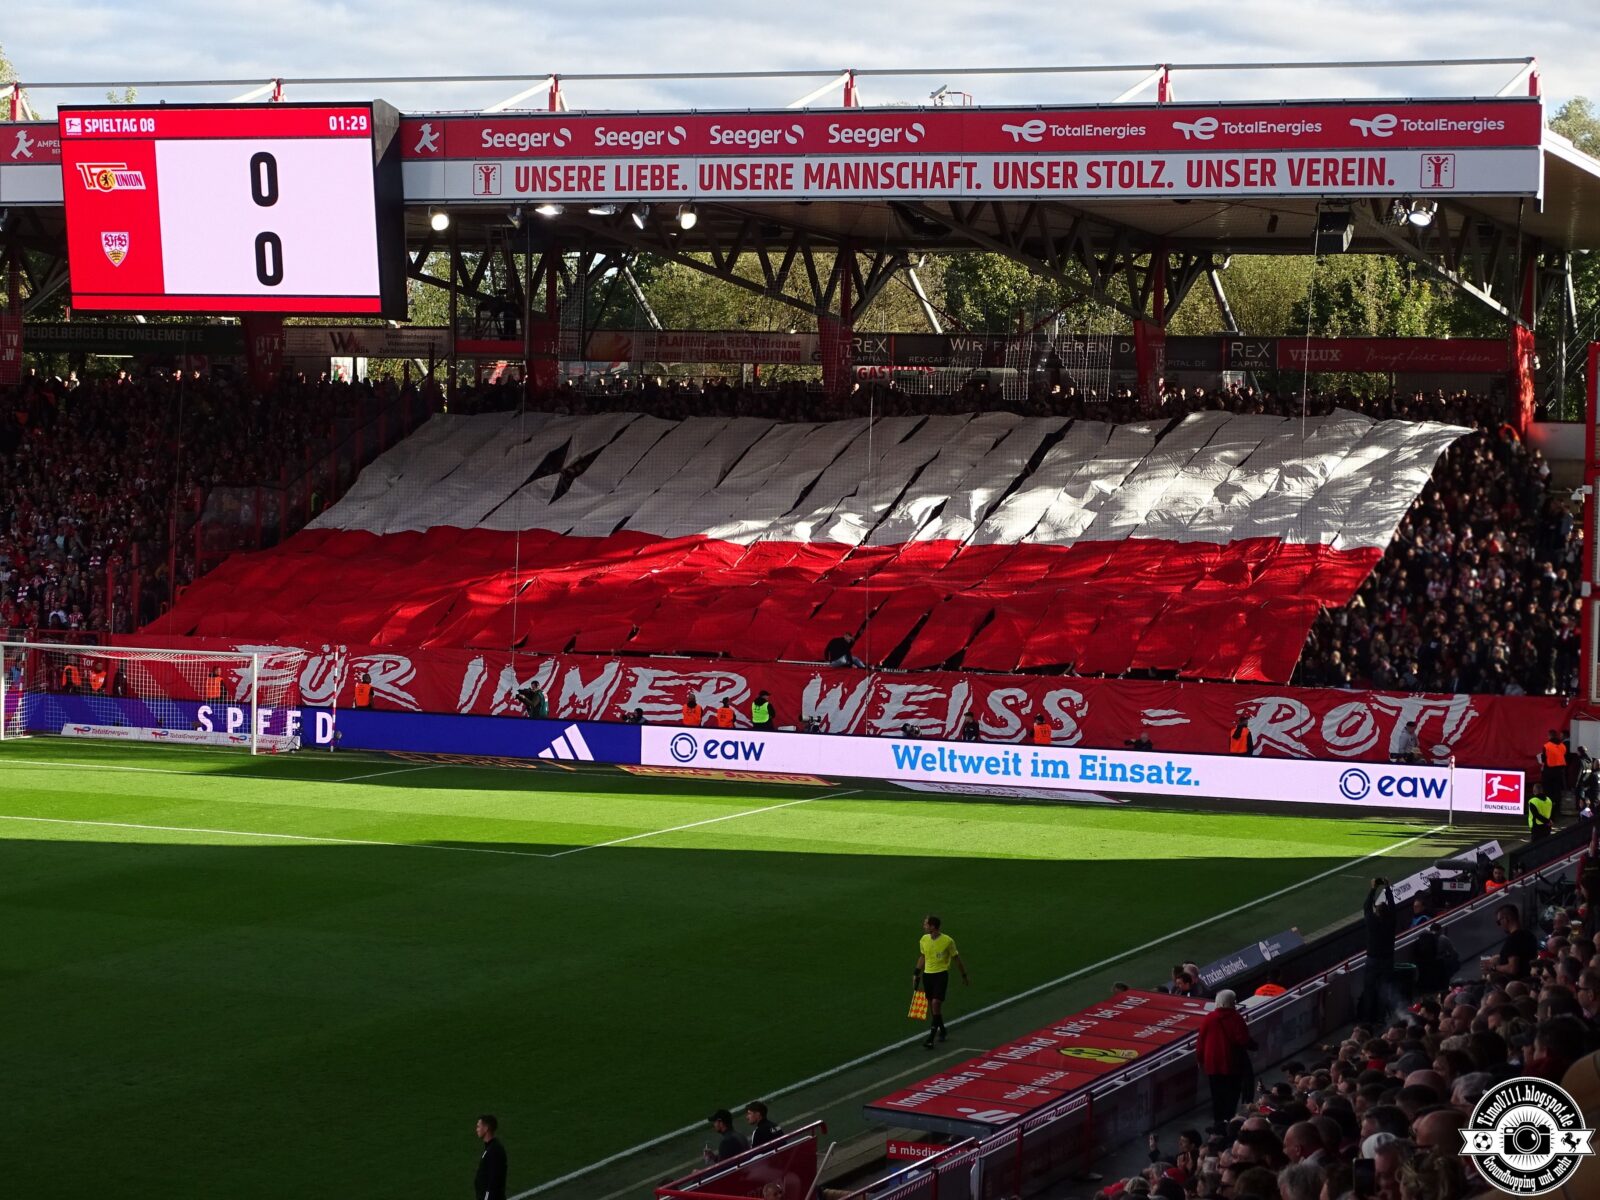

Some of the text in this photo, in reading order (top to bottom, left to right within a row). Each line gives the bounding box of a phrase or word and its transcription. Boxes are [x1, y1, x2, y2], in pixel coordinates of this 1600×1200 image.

[84, 117, 155, 133] SPIELTAG 08
[328, 115, 368, 131] 01:29
[1049, 123, 1146, 139] TotalEnergies
[1221, 119, 1322, 136] TotalEnergies
[1400, 117, 1505, 134] TotalEnergies
[481, 126, 550, 151] Seeger
[594, 125, 664, 149] Seeger
[709, 123, 781, 148] Seeger
[828, 122, 902, 147] Seeger
[115, 173, 143, 187] UNION
[249, 151, 279, 207] 0
[515, 157, 1394, 193] UNSERE LIEBE. UNSERE MANNSCHAFT. UNSER STOLZ. UNSER VEREIN.
[254, 231, 284, 287] 0
[949, 337, 984, 352] WIR
[1289, 349, 1341, 362] VELUX
[1230, 360, 1271, 369] CAPITAL
[228, 643, 421, 713] FÜR
[456, 656, 753, 728] IMMER
[799, 672, 1089, 745] WEISS
[1235, 694, 1479, 764] ROT!
[91, 728, 128, 737] TotalEnergies
[169, 732, 207, 741] TotalEnergies
[703, 739, 765, 762] eaw
[891, 745, 1200, 787] Weltweit im Einsatz.
[1377, 775, 1447, 799] eaw
[1485, 803, 1521, 812] BUNDESLIGA
